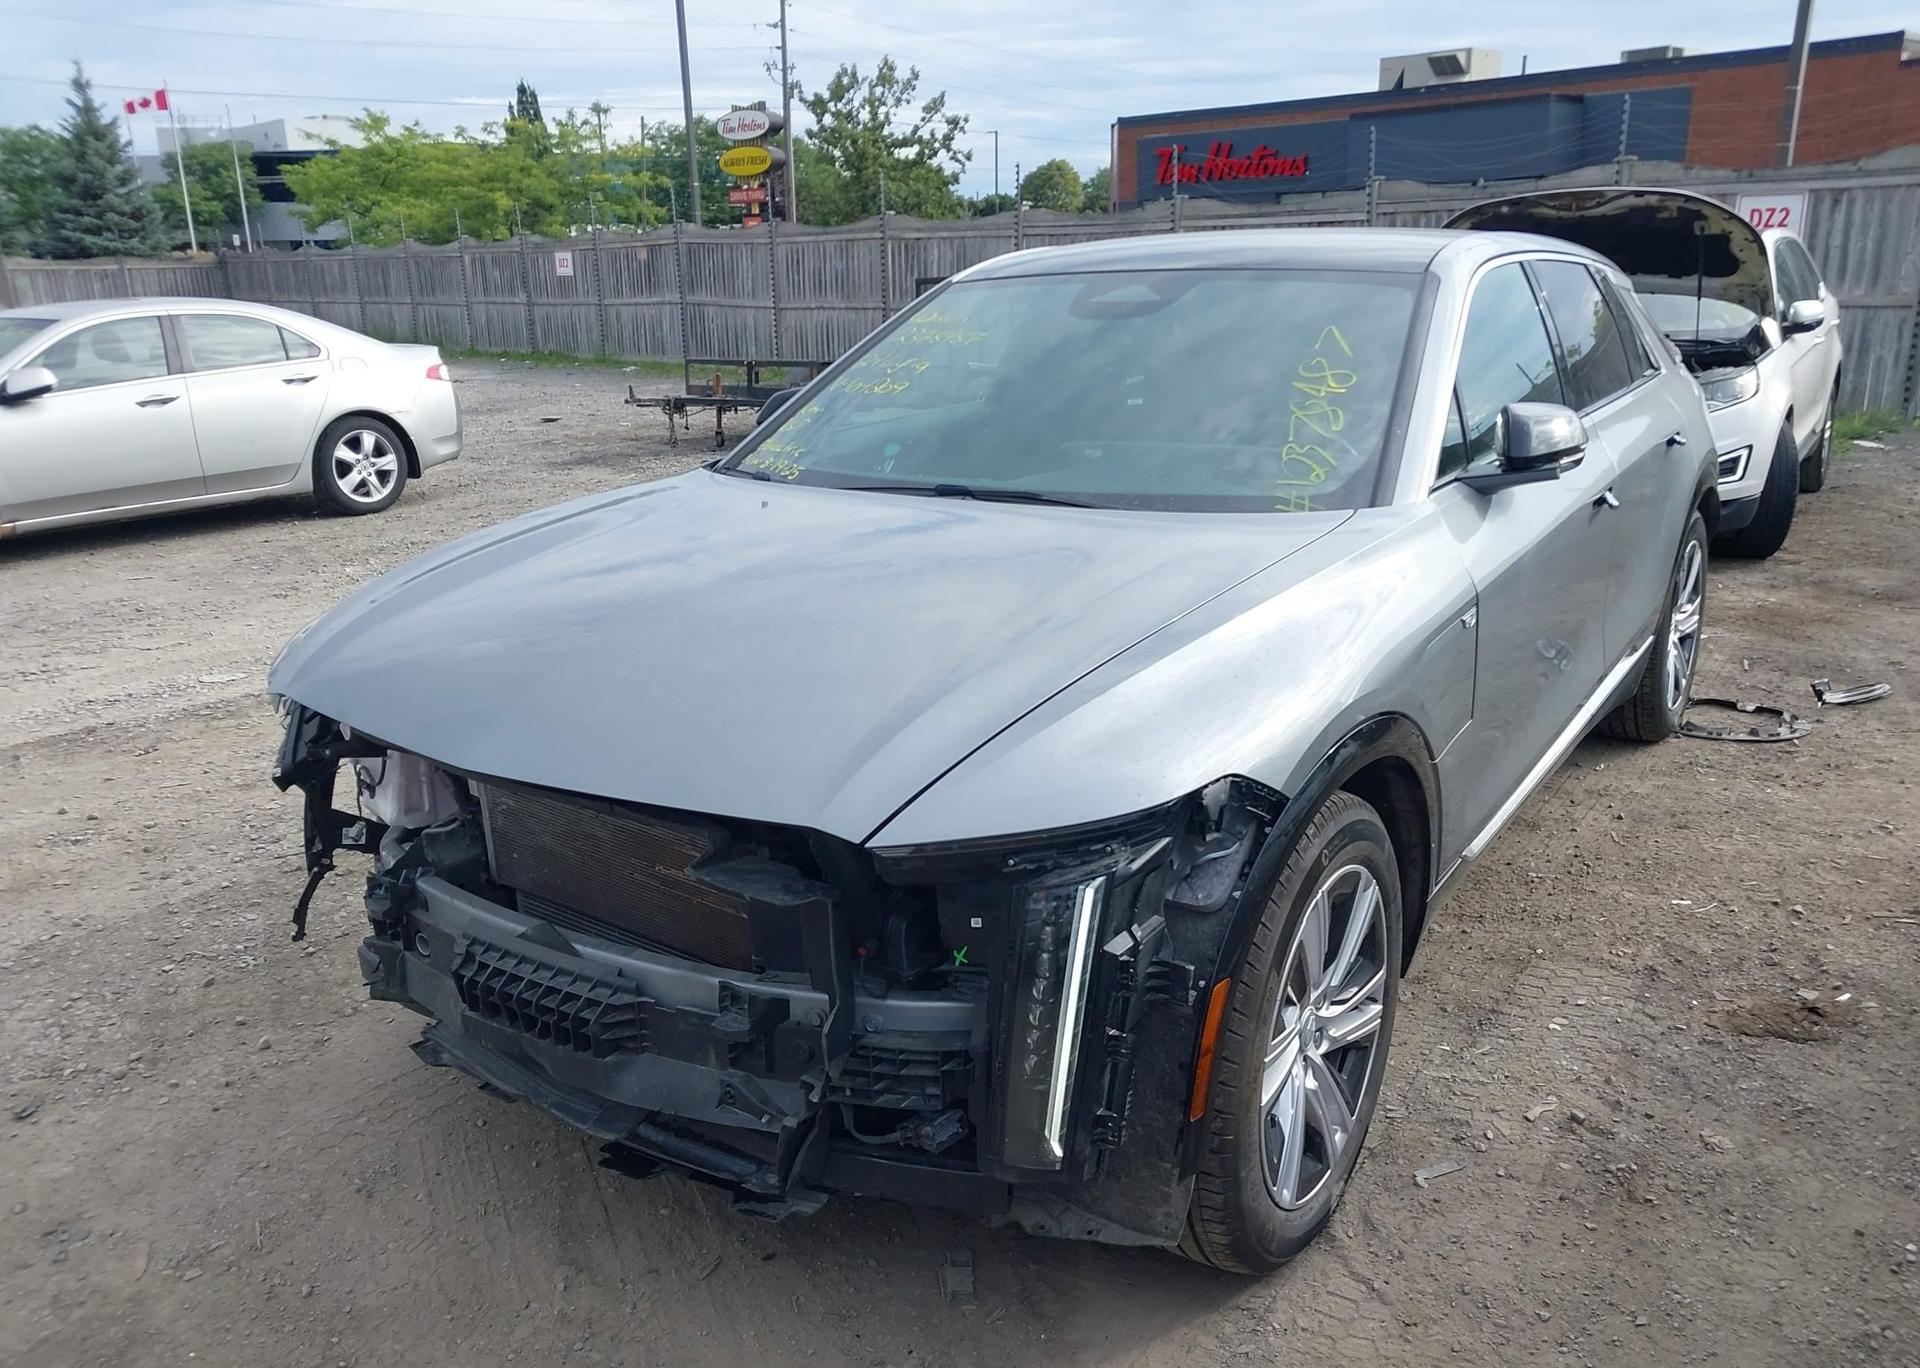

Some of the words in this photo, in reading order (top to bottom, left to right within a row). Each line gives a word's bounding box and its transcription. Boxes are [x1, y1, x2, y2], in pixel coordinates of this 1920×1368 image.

[720, 118, 736, 135] Tim
[736, 116, 766, 132] Hortons
[1156, 145, 1200, 185] Tim
[1202, 139, 1308, 181] Hortons
[1750, 207, 1790, 228] DZ2
